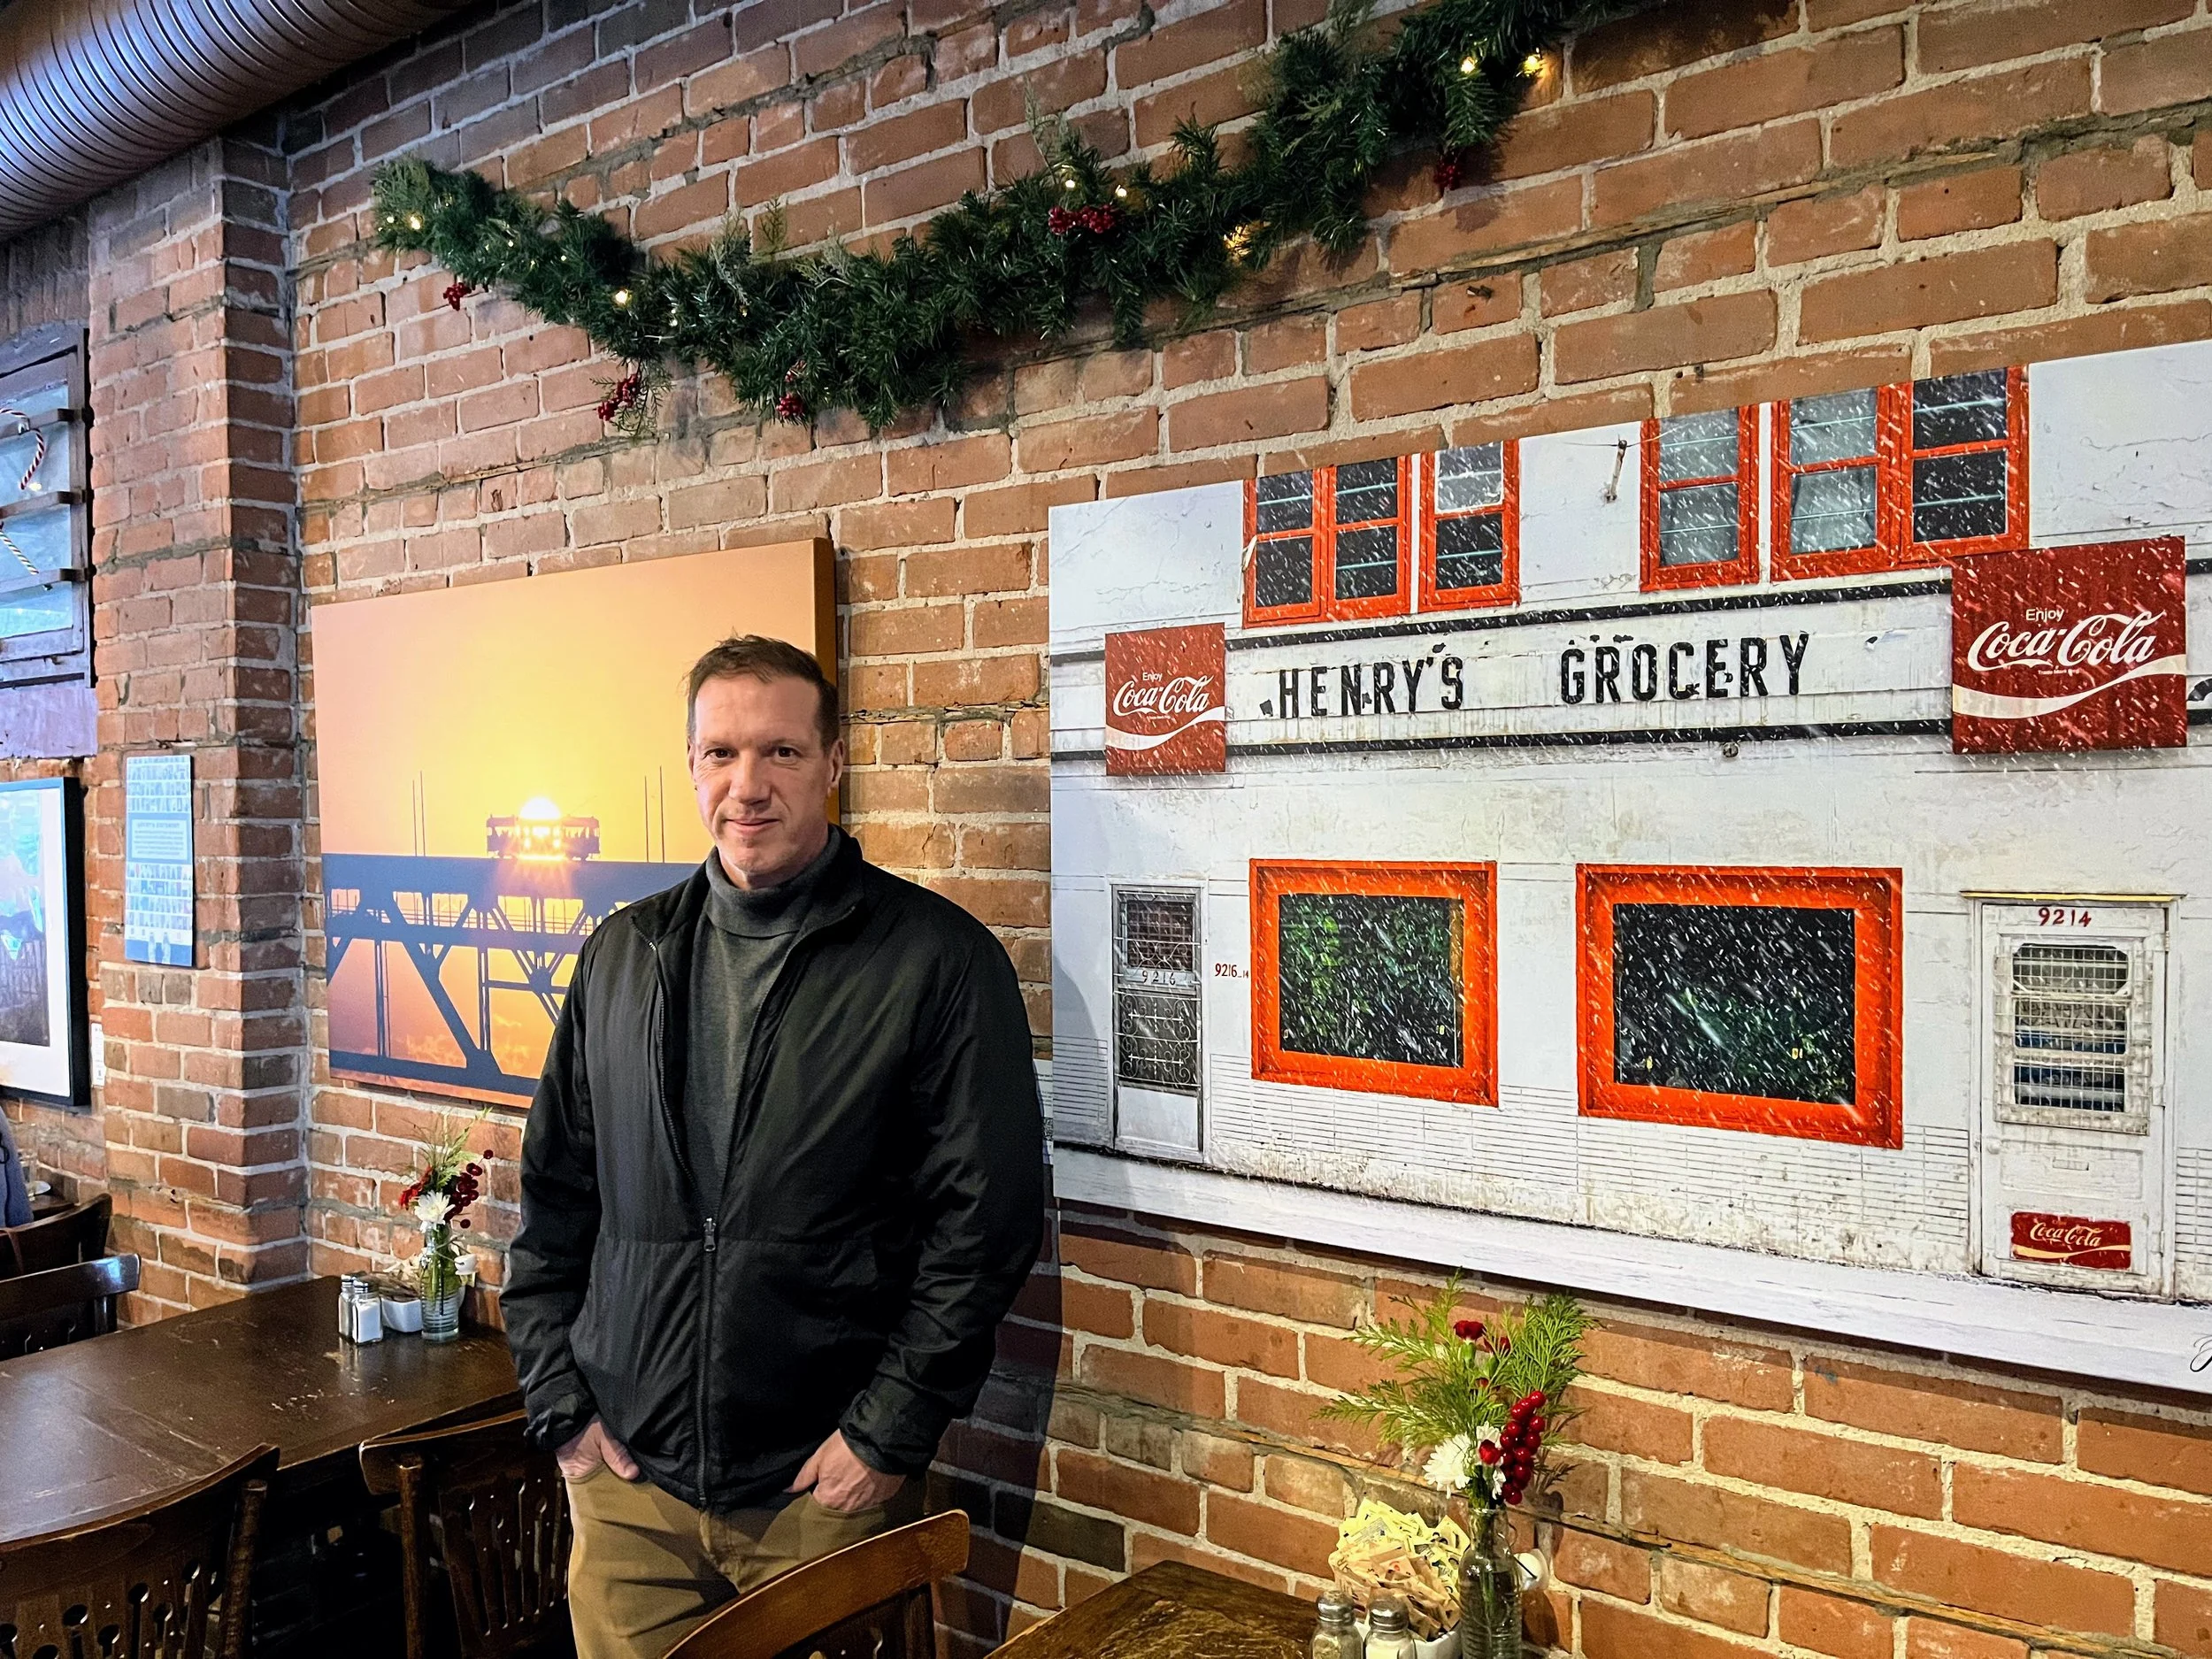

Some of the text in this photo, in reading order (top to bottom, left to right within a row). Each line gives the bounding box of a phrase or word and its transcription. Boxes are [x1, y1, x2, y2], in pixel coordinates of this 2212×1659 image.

[2026, 607, 2064, 623] Enjoy
[1967, 609, 2166, 672] Coca-Cola
[1142, 672, 1163, 682] Enjoy
[1279, 632, 1809, 719] HENRY'S GROCERY
[1113, 674, 1214, 717] Coca-Cola
[2038, 906, 2093, 928] 9214
[1141, 969, 1176, 986] 9216
[2030, 1222, 2104, 1247] Coca-Cola
